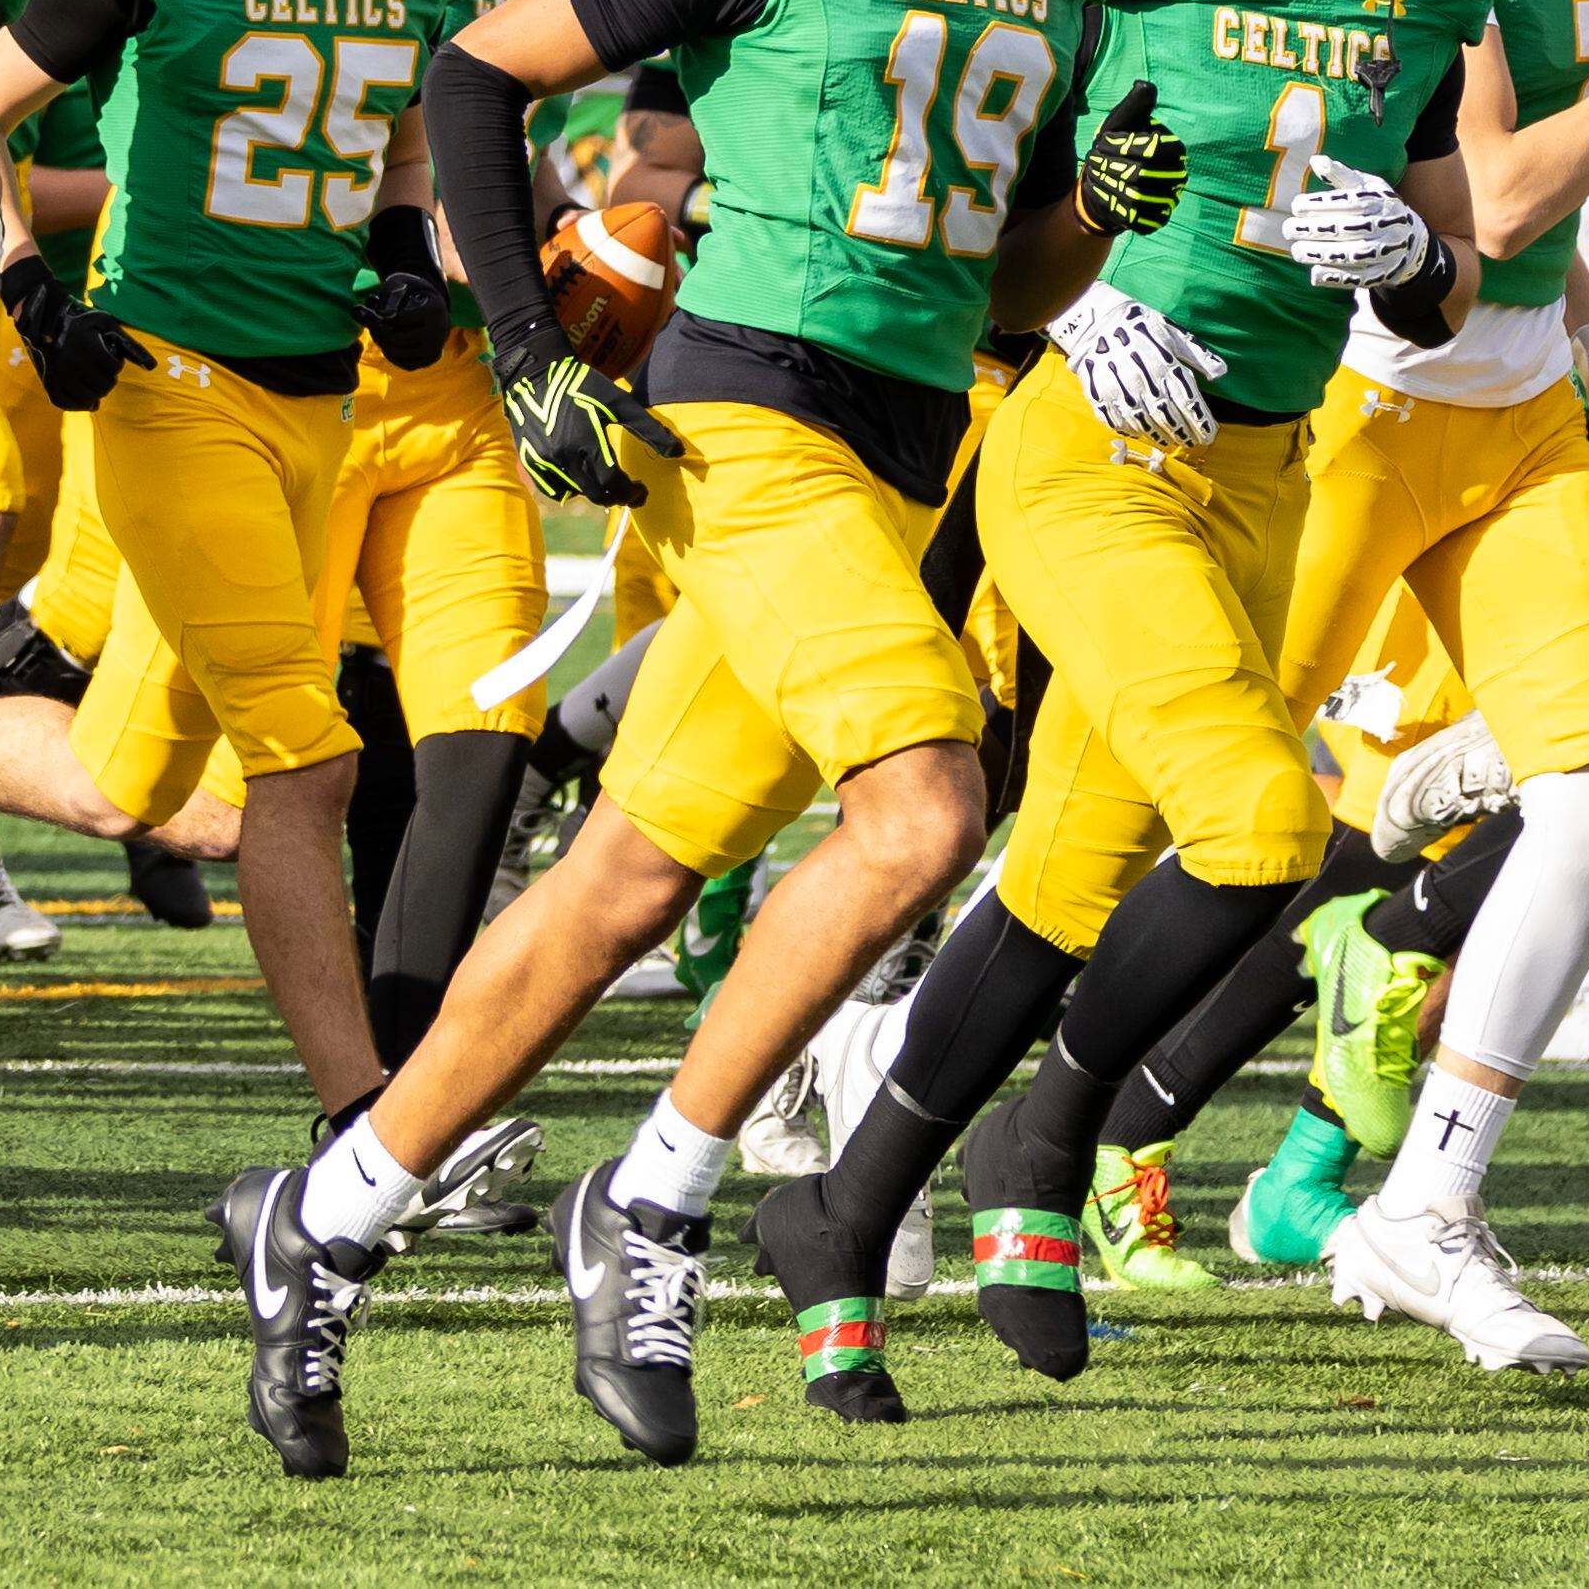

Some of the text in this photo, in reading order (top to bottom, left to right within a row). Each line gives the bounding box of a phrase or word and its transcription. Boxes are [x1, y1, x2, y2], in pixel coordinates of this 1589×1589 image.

[204, 31, 420, 232] 25
[844, 9, 1057, 258] 19
[1233, 80, 1326, 259] 1
